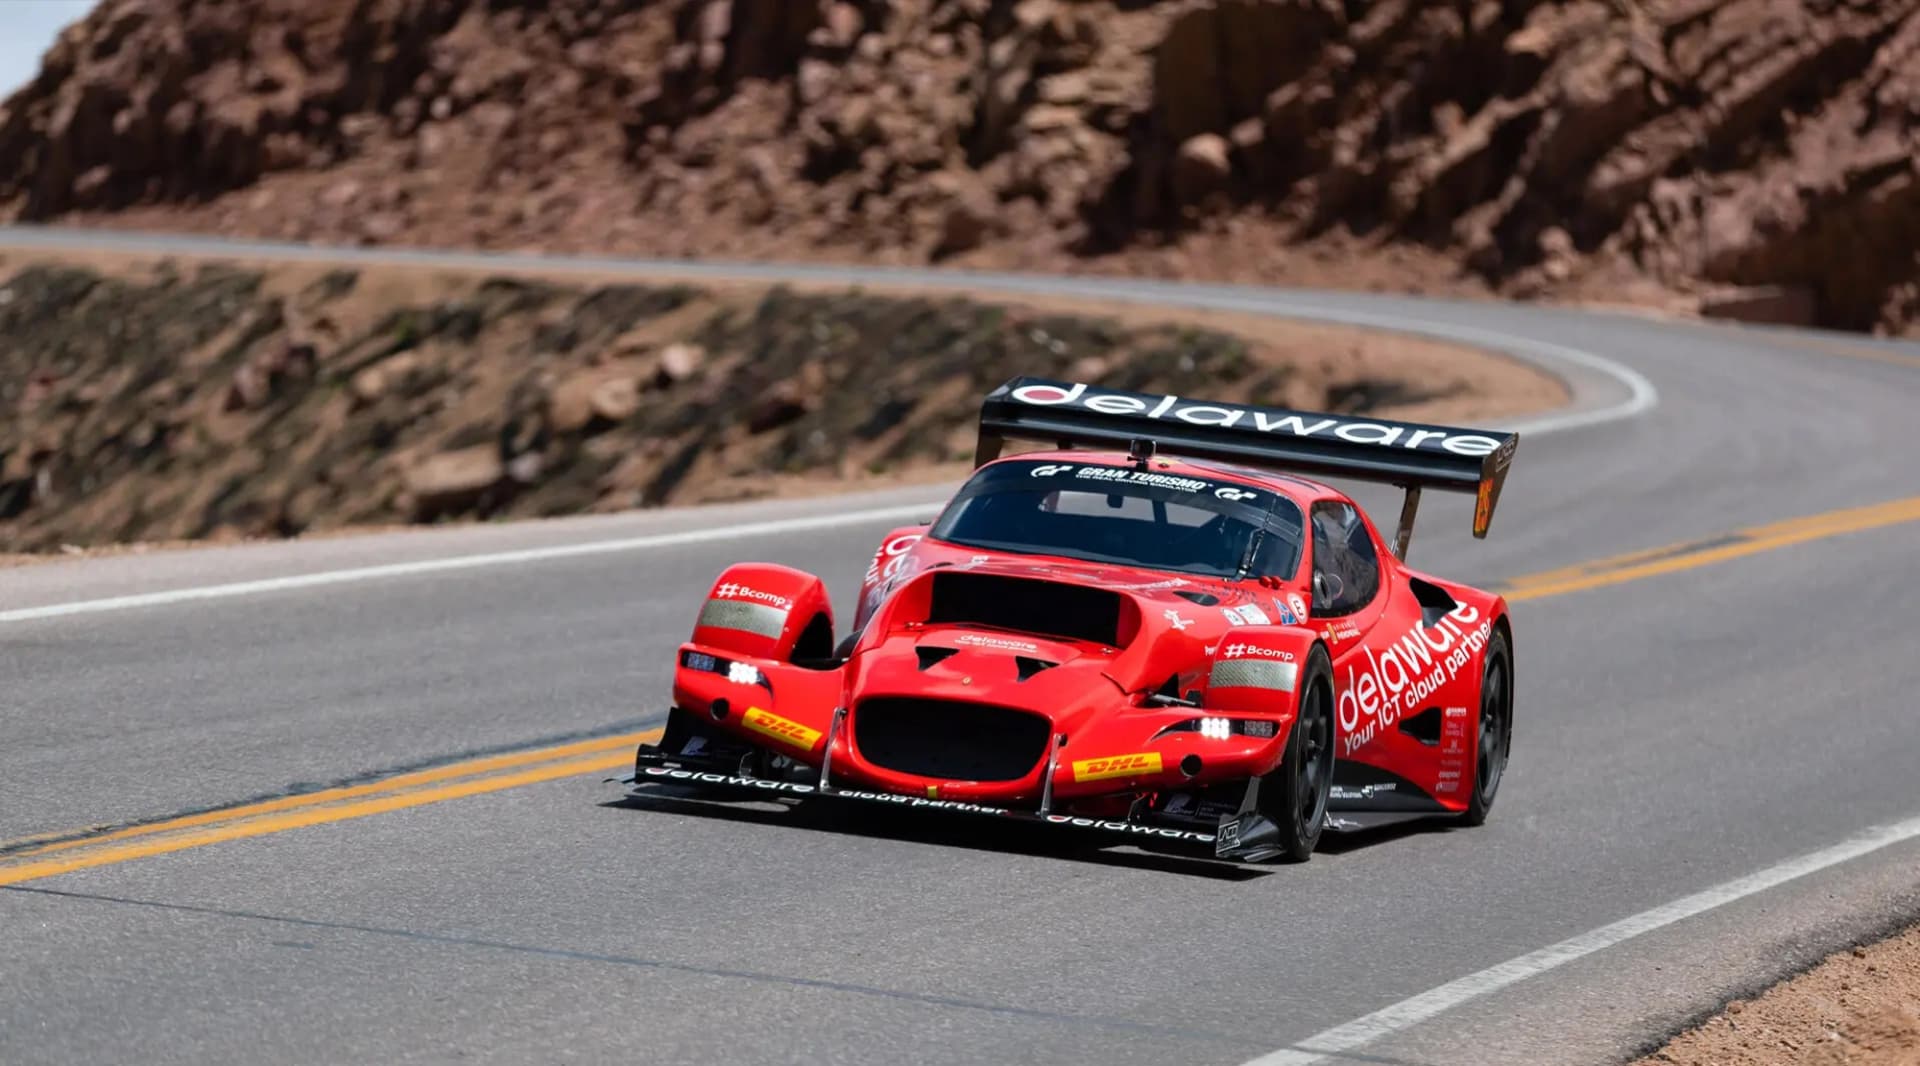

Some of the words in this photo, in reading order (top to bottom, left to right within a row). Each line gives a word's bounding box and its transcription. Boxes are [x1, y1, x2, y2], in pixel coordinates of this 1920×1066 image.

[1012, 383, 1502, 456] delaware
[1078, 467, 1129, 478] GRAN
[1130, 472, 1207, 490] TURISMO
[1340, 599, 1479, 732] delaware
[1344, 719, 1376, 756] Your
[1377, 693, 1401, 732] ICT
[1405, 661, 1446, 708] cloud
[1444, 616, 1491, 681] partner
[754, 714, 805, 740] DHL
[1087, 756, 1149, 774] DHL
[645, 767, 815, 793] delaware
[838, 790, 908, 803] cloud
[911, 799, 1008, 814] partner
[1046, 814, 1217, 842] delaware
